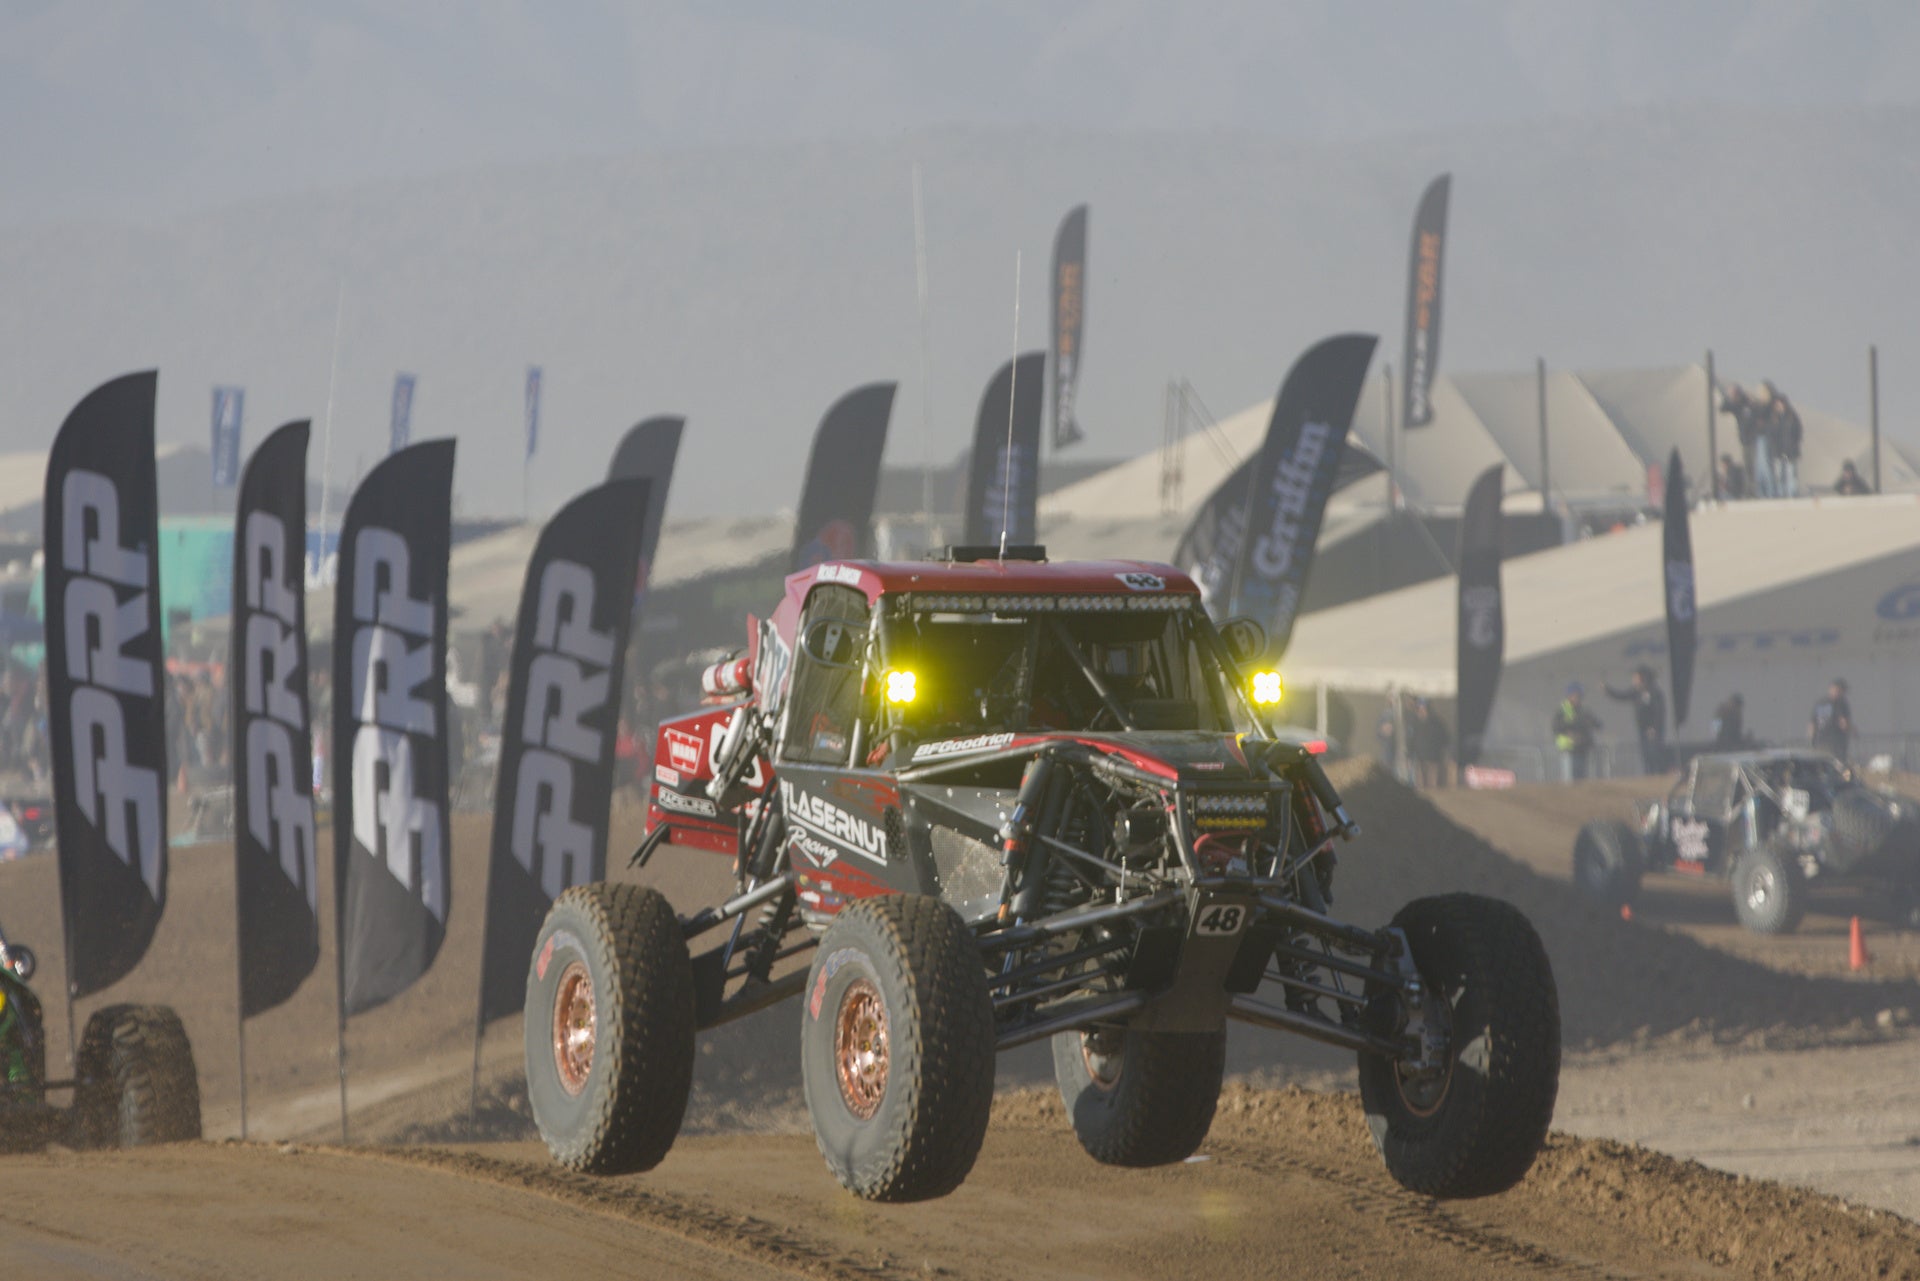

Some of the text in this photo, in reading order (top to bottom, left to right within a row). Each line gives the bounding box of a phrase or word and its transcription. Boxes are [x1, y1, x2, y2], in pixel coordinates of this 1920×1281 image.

[61, 468, 161, 902] PRP
[244, 509, 318, 918] PRP
[351, 526, 446, 927] PRP
[510, 558, 616, 902] PRP
[787, 824, 839, 868] Racing
[788, 781, 887, 860] LASERNUT
[1200, 907, 1241, 932] 48
